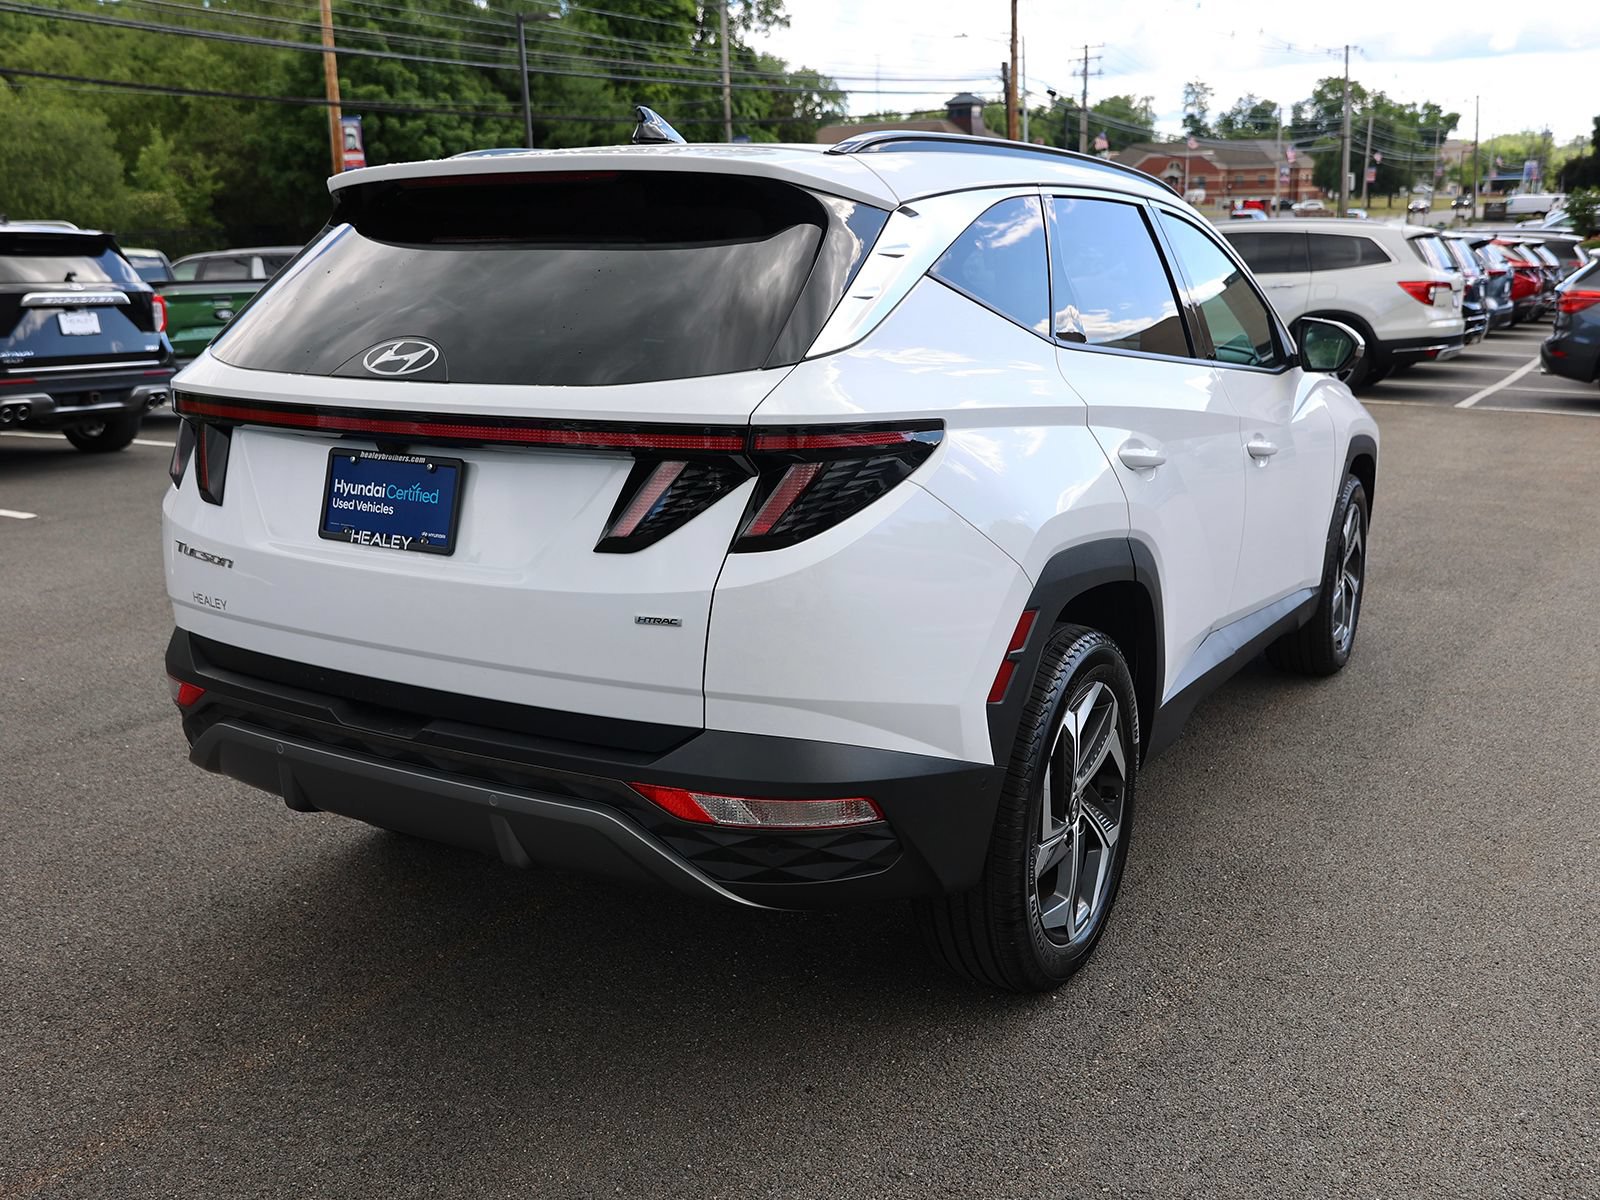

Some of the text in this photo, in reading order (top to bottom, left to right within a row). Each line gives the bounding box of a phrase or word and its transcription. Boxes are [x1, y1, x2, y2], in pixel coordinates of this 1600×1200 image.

[360, 451, 425, 463] healeybrothers.com
[334, 479, 439, 504] Hyundai Certified
[332, 498, 394, 515] Used Vehicles
[350, 529, 412, 550] HEALEY
[192, 592, 227, 610] HEALEY
[637, 616, 679, 625] HTRAC
